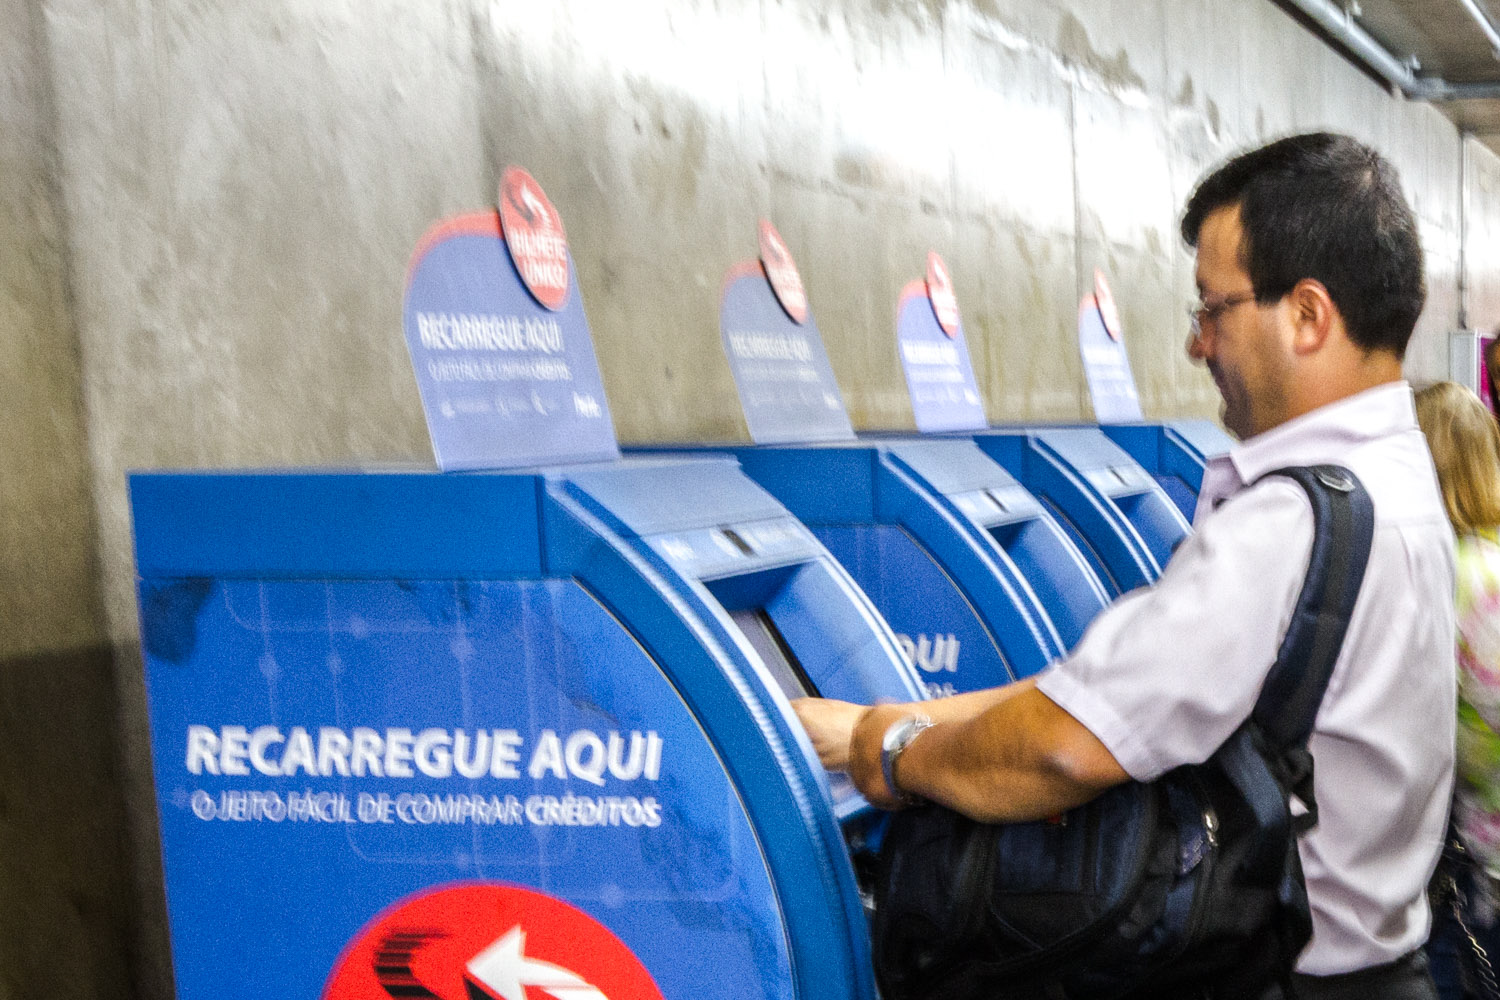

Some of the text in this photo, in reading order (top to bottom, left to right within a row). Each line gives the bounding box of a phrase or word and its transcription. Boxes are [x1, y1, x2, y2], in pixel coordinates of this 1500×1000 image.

[186, 725, 664, 786] RECARREGUE AQUI
[191, 786, 662, 828] O JEITO FÁCIL DE COMPRAR CRÉDITOS
